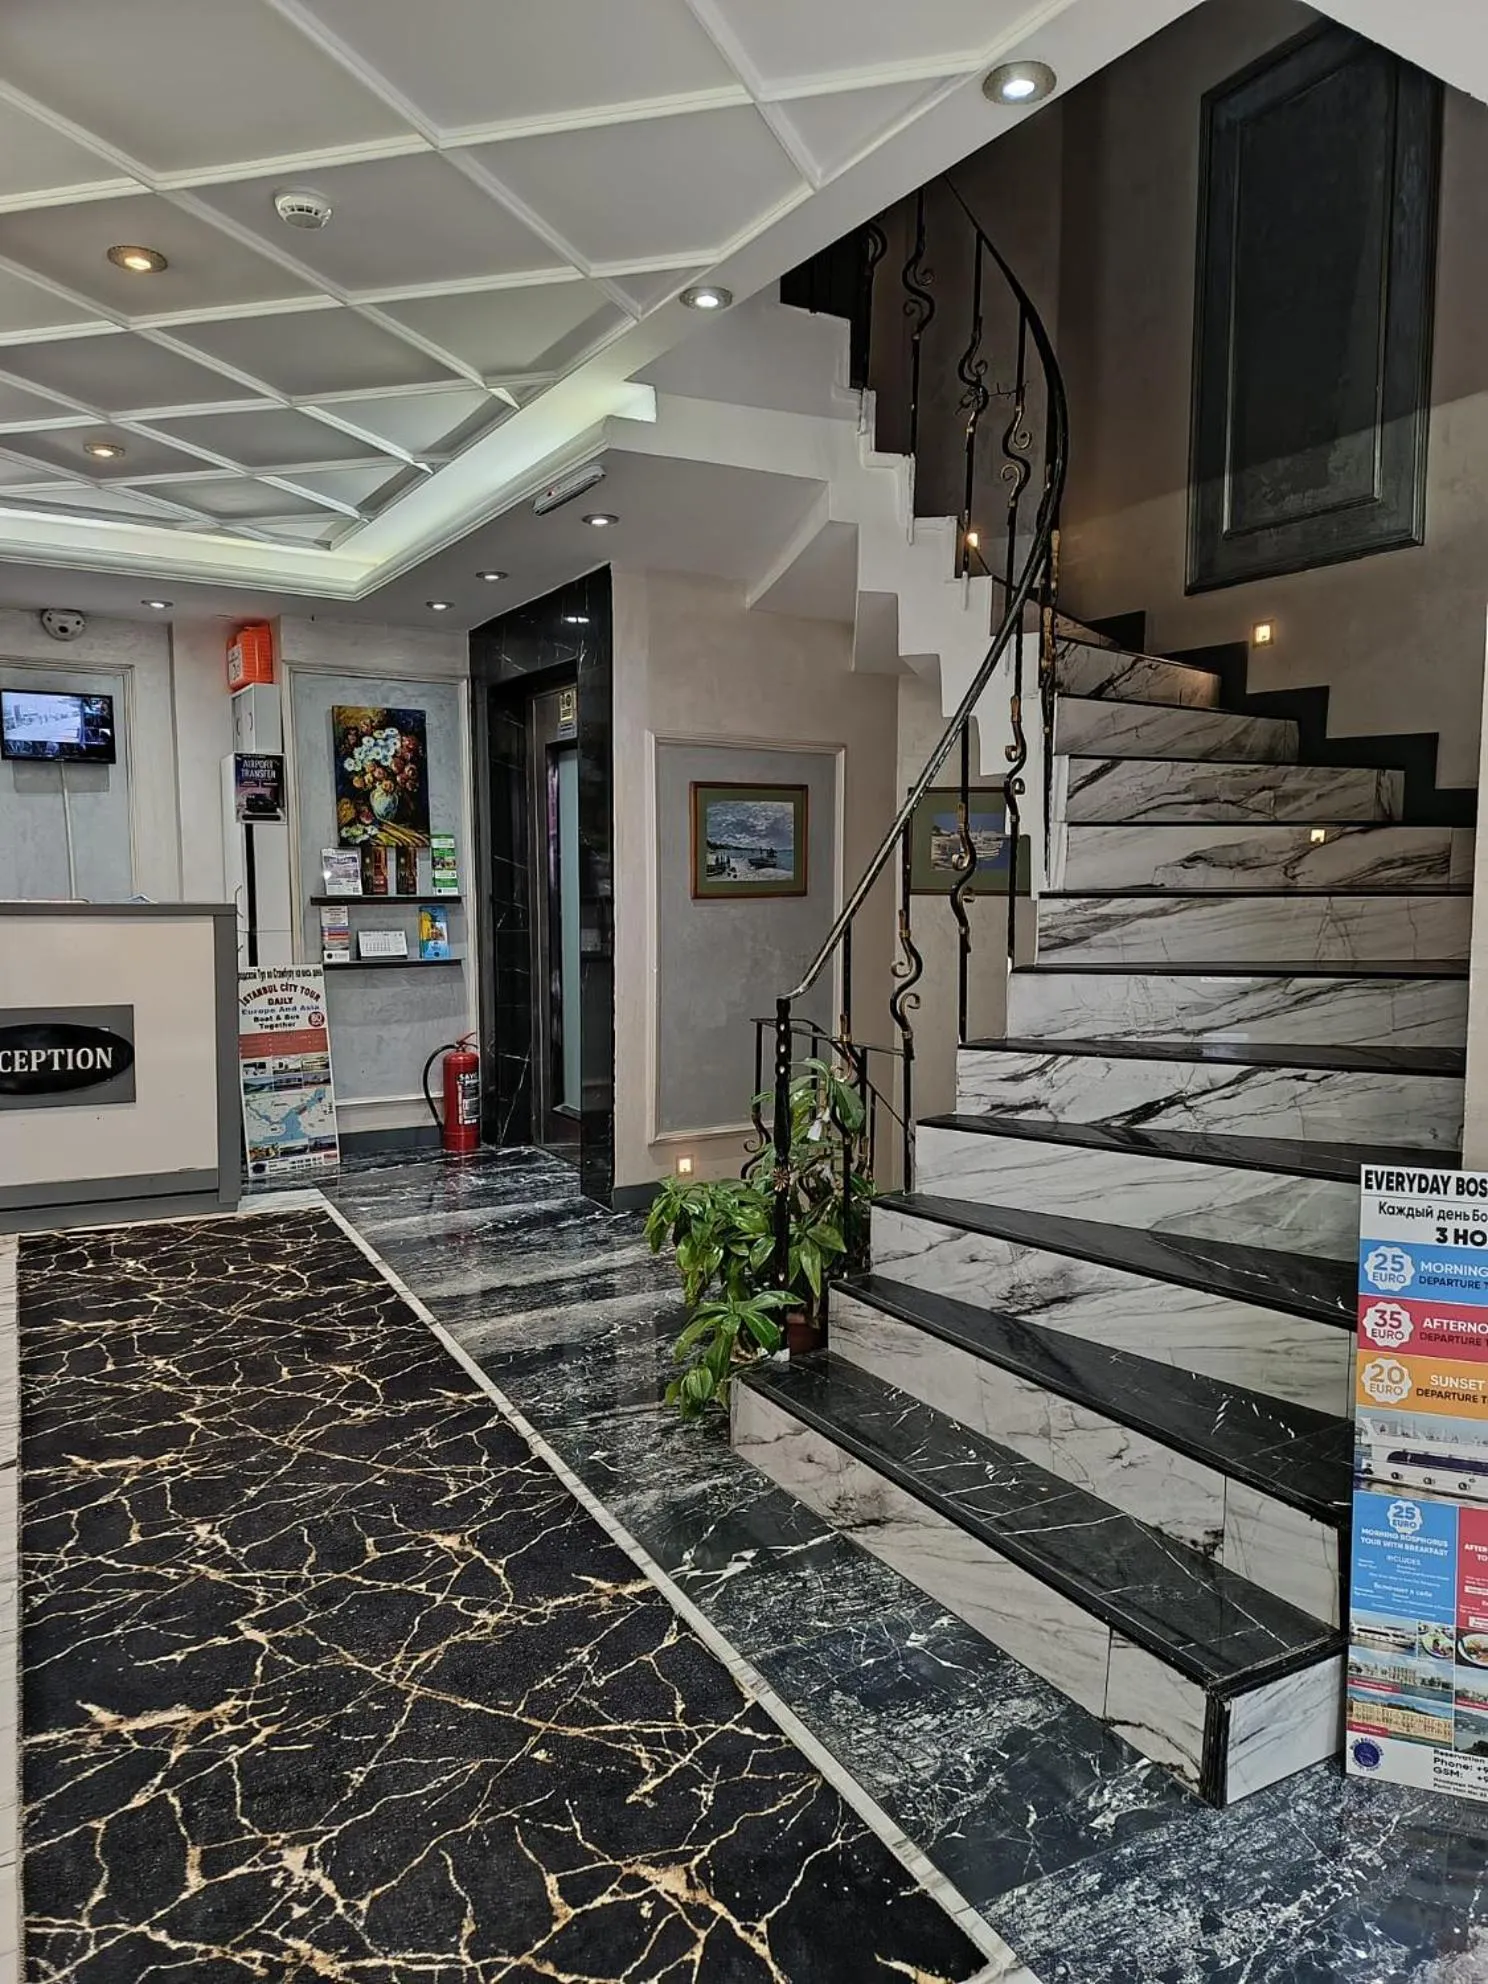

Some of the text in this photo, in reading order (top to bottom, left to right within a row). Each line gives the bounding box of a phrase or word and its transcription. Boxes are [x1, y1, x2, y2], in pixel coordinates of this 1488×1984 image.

[299, 985, 321, 1002] TOUR
[267, 997, 294, 1006] DAILY
[241, 1008, 276, 1016] Europe
[278, 1005, 298, 1013] And
[253, 1015, 273, 1023] Boat
[258, 1021, 296, 1030] Together
[0, 1047, 113, 1073] CEPTION
[1364, 1169, 1488, 1198] EVERYDAY BOS
[1378, 1201, 1434, 1219] Каждый
[1437, 1208, 1470, 1221] день
[1435, 1227, 1488, 1246] 3 HO
[1373, 1253, 1405, 1272] 25
[1420, 1261, 1488, 1277] MORNING
[1372, 1271, 1407, 1284] EURO
[1419, 1276, 1481, 1289] DEPARTURE
[1374, 1309, 1403, 1329] 35
[1422, 1318, 1488, 1334] AFTERNO
[1371, 1328, 1405, 1341] EURO
[1419, 1332, 1482, 1346] DEPARTURE
[1369, 1363, 1405, 1384] 20
[1369, 1383, 1404, 1396] EURO
[1430, 1374, 1487, 1391] SUNSET
[1416, 1388, 1479, 1403] DEPARTURE
[1392, 1505, 1416, 1520] 25
[1392, 1519, 1417, 1529] EURO
[1361, 1528, 1448, 1547] MORNING BOSPHORUS
[1360, 1536, 1449, 1556] TOUR WITH BREAKFAST
[1386, 1555, 1421, 1566] INCLUDES
[1433, 1749, 1485, 1764] Reservation
[1433, 1757, 1473, 1771] Phone:
[1433, 1766, 1464, 1778] GSM:
